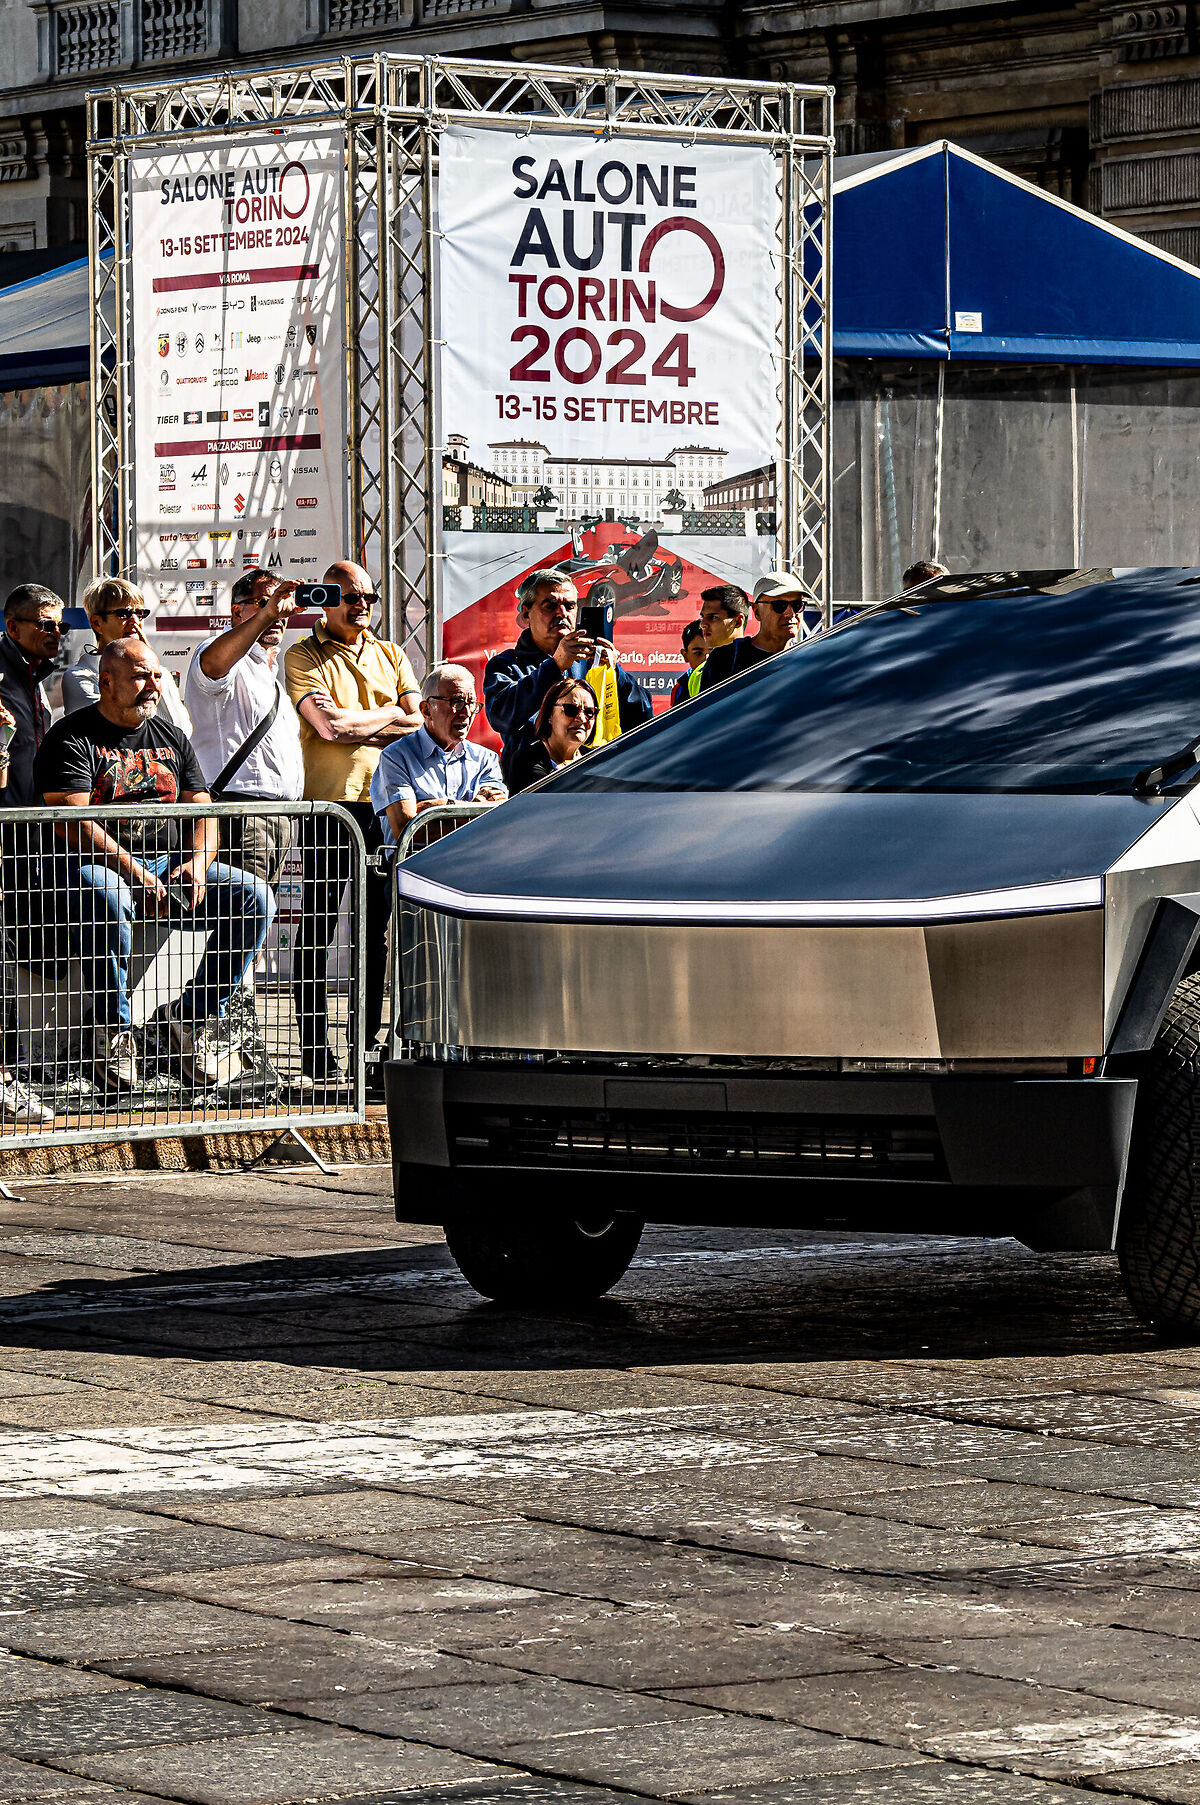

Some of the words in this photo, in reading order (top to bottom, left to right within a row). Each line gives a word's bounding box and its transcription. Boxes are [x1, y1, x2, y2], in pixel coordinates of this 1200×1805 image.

[160, 171, 235, 205] SALONE
[241, 161, 310, 205] AUTO
[512, 155, 697, 208] SALONE
[224, 184, 310, 224] TORINO
[160, 237, 191, 257] 13-15
[194, 228, 273, 253] SETTEMBRE
[275, 226, 309, 247] 2024
[509, 208, 726, 292] AUTO
[219, 274, 230, 285] VIA
[230, 272, 251, 283] ROMA
[222, 300, 245, 311] BYD
[246, 333, 262, 344] Jeep
[509, 325, 697, 387] 2024
[495, 394, 557, 422] 13-15
[563, 398, 720, 426] SETTEMBRE
[157, 415, 179, 425] TIGER
[207, 441, 229, 452] PIAZZA
[230, 439, 263, 451] CASTELLO
[291, 466, 319, 475] NISSAN
[159, 503, 182, 514] Polestar
[197, 503, 222, 511] HONDA
[160, 533, 178, 542] auto
[162, 646, 191, 657] McLaren
[647, 650, 685, 667] piazza
[657, 677, 665, 689] 9
